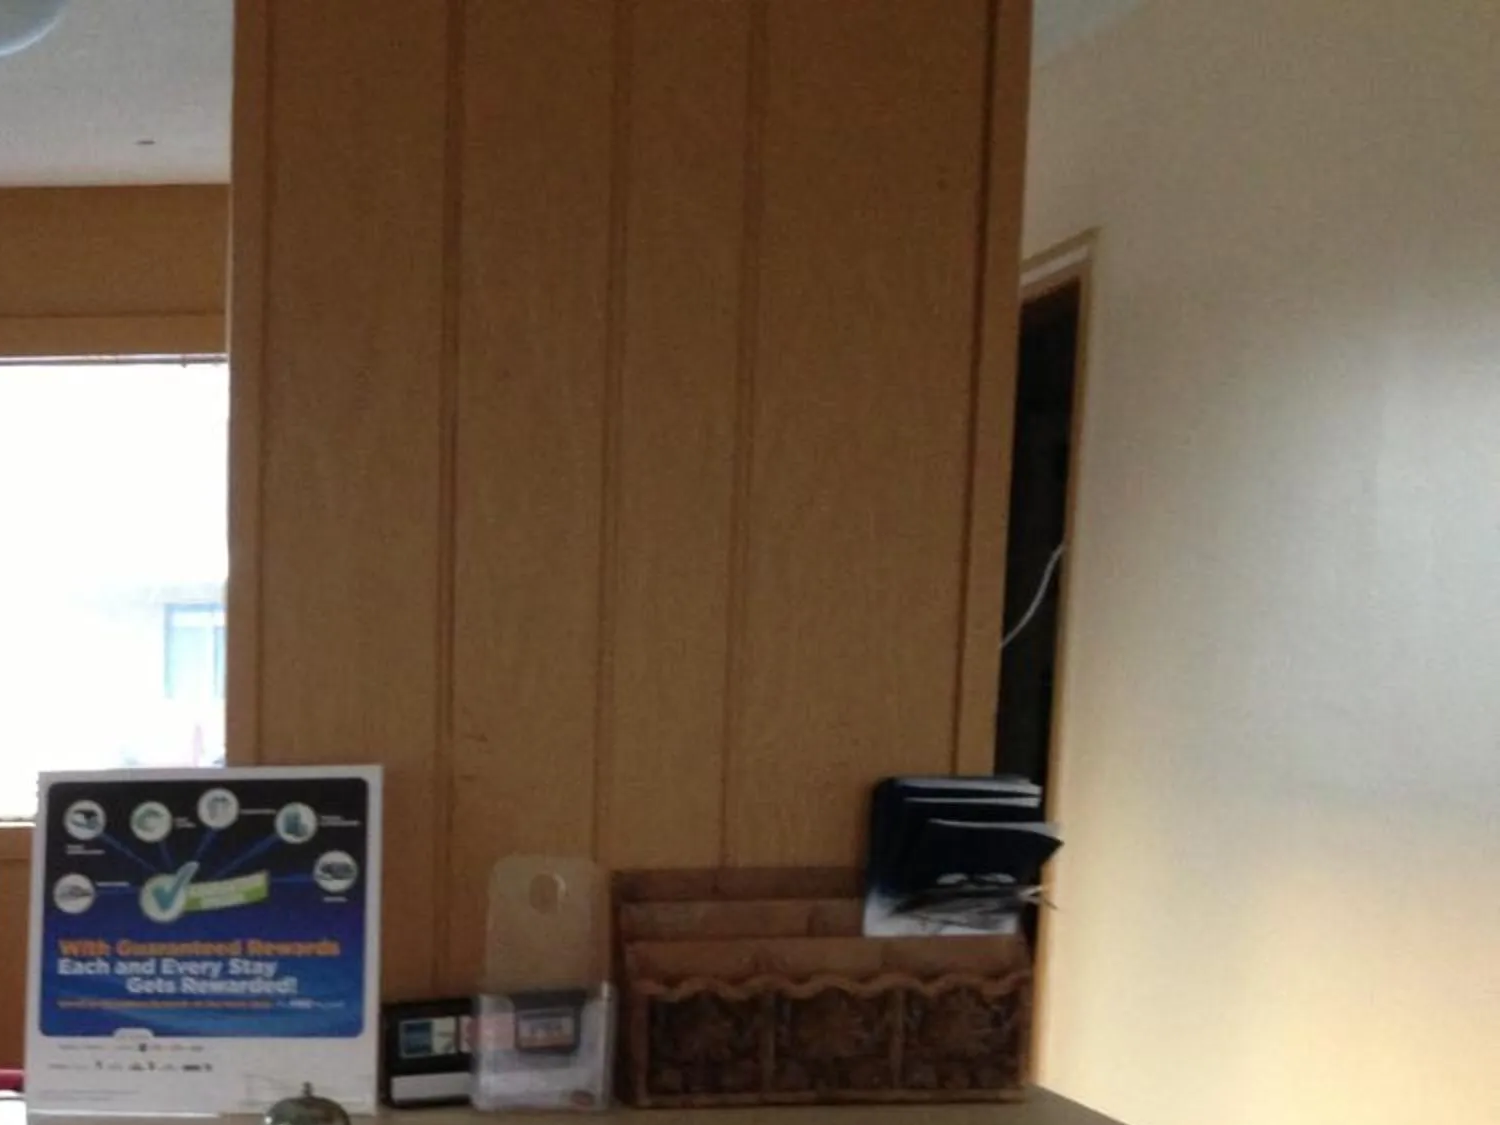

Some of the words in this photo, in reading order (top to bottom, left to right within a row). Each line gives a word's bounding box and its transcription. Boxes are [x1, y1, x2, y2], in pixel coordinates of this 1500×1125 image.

[59, 940, 110, 957] With
[57, 958, 110, 976] Each
[114, 958, 156, 975] and
[161, 958, 223, 978] Every
[228, 957, 278, 977] Stay
[126, 976, 177, 994] Gets
